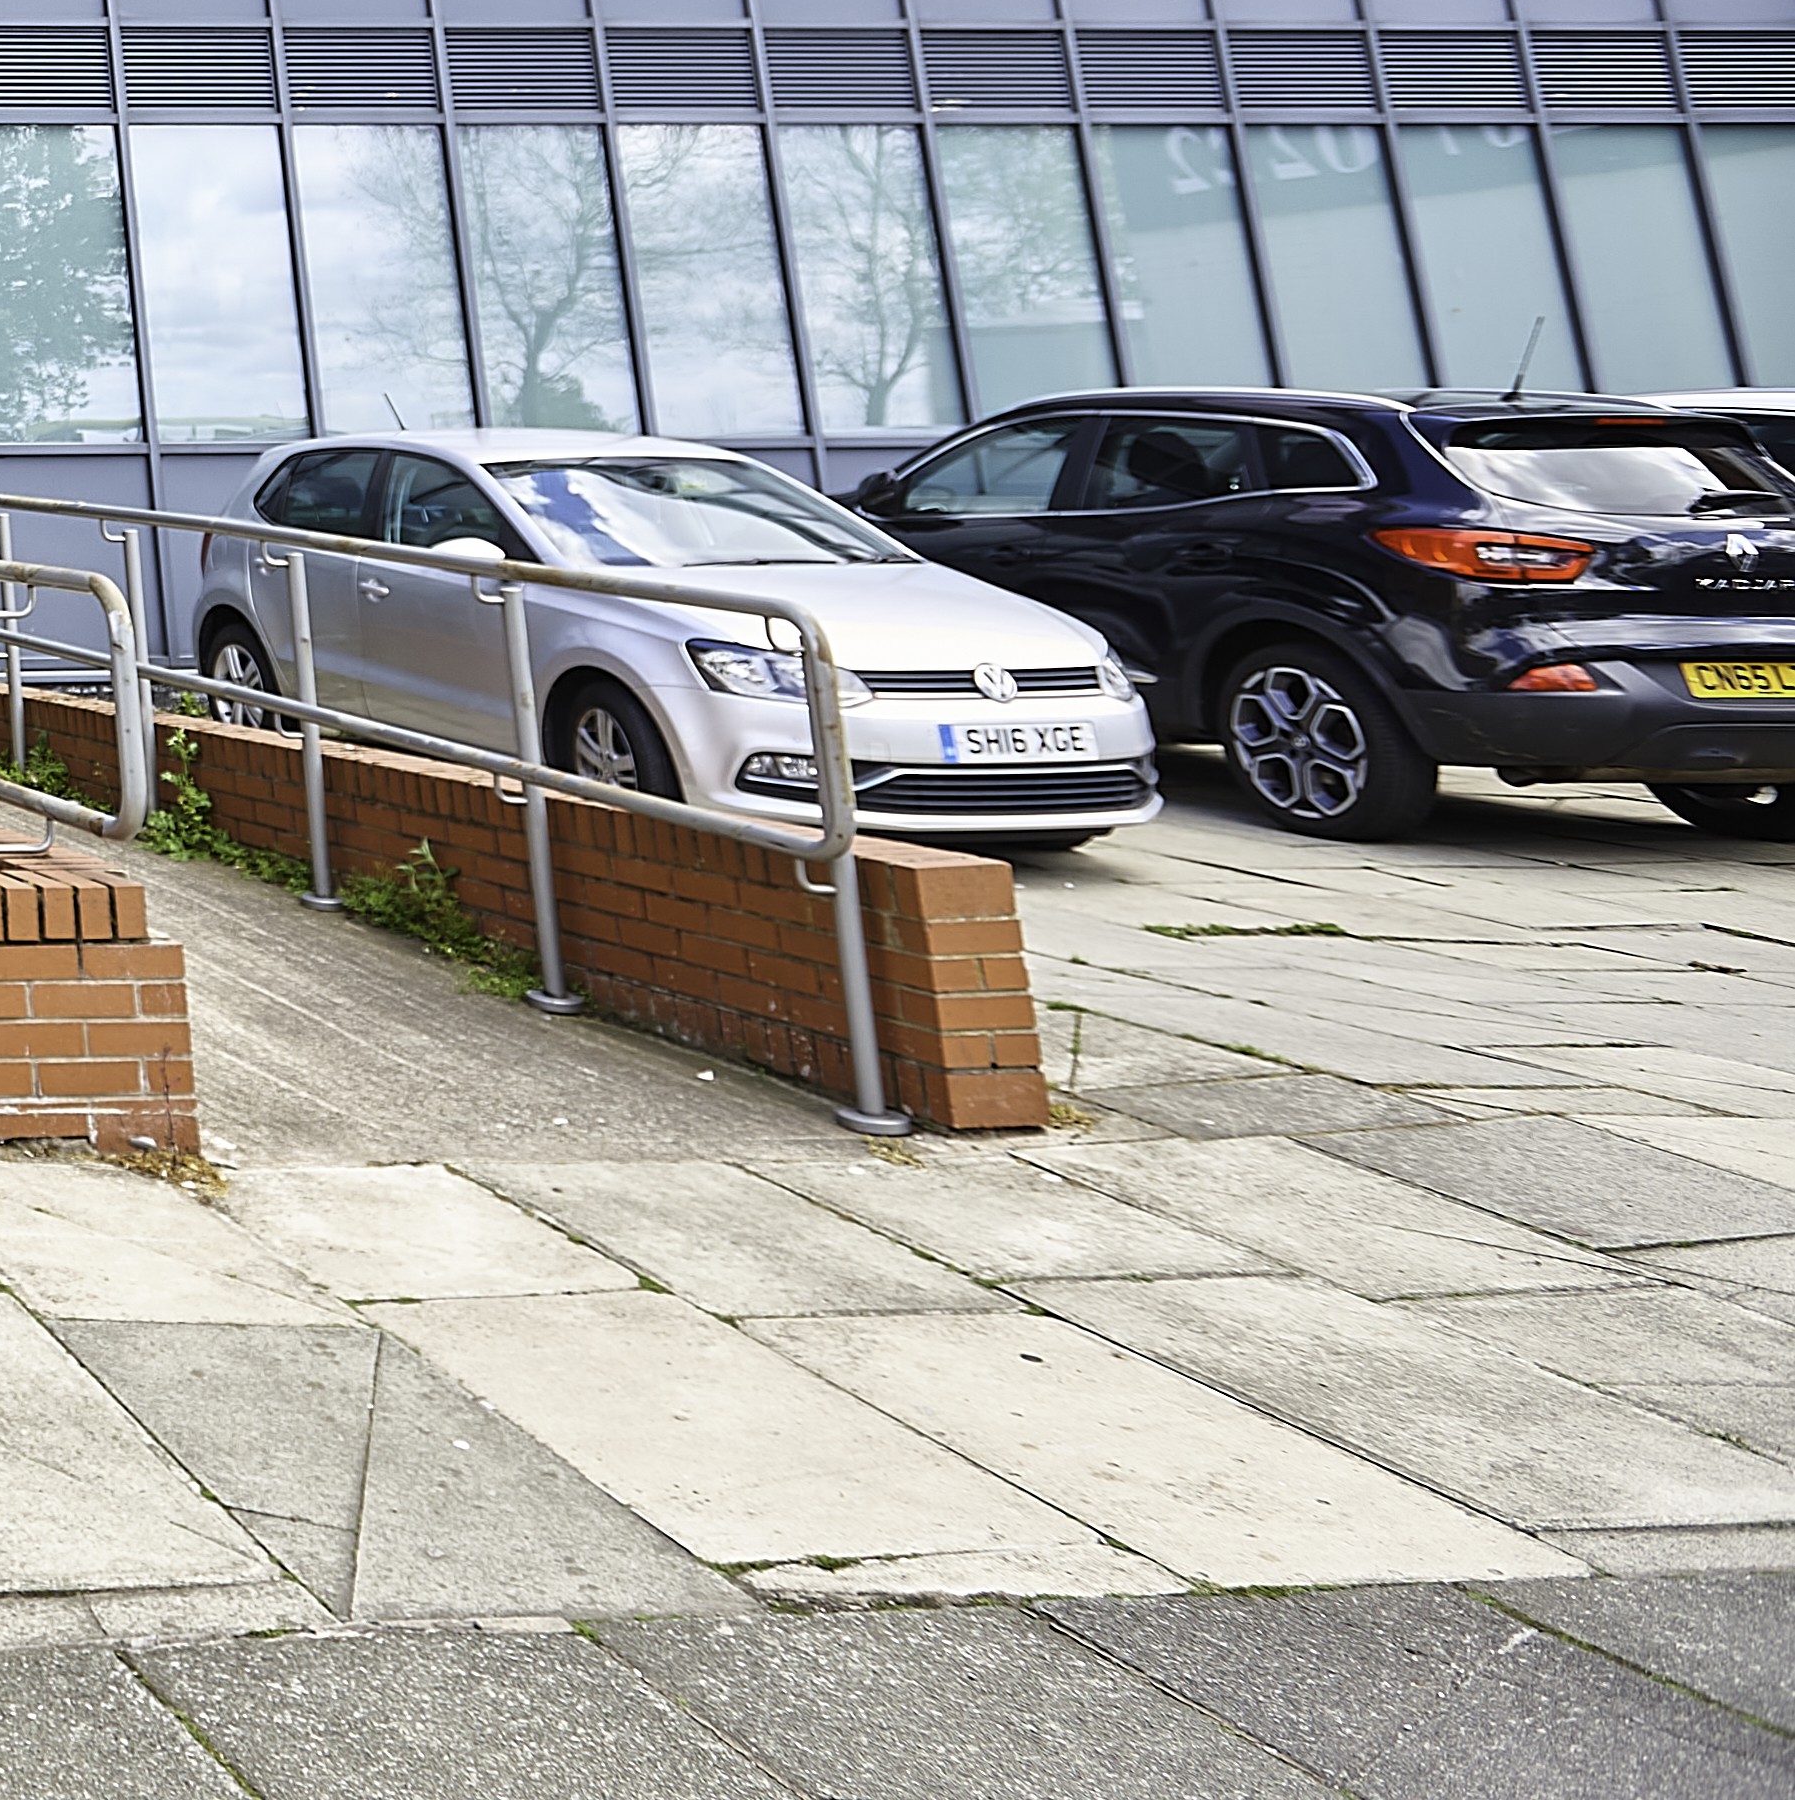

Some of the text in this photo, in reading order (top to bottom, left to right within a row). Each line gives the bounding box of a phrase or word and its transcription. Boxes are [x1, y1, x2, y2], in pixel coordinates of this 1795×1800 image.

[1694, 578, 1795, 590] KADJAR
[1696, 664, 1795, 691] CN65 L
[966, 725, 1087, 755] SH16 XGE
